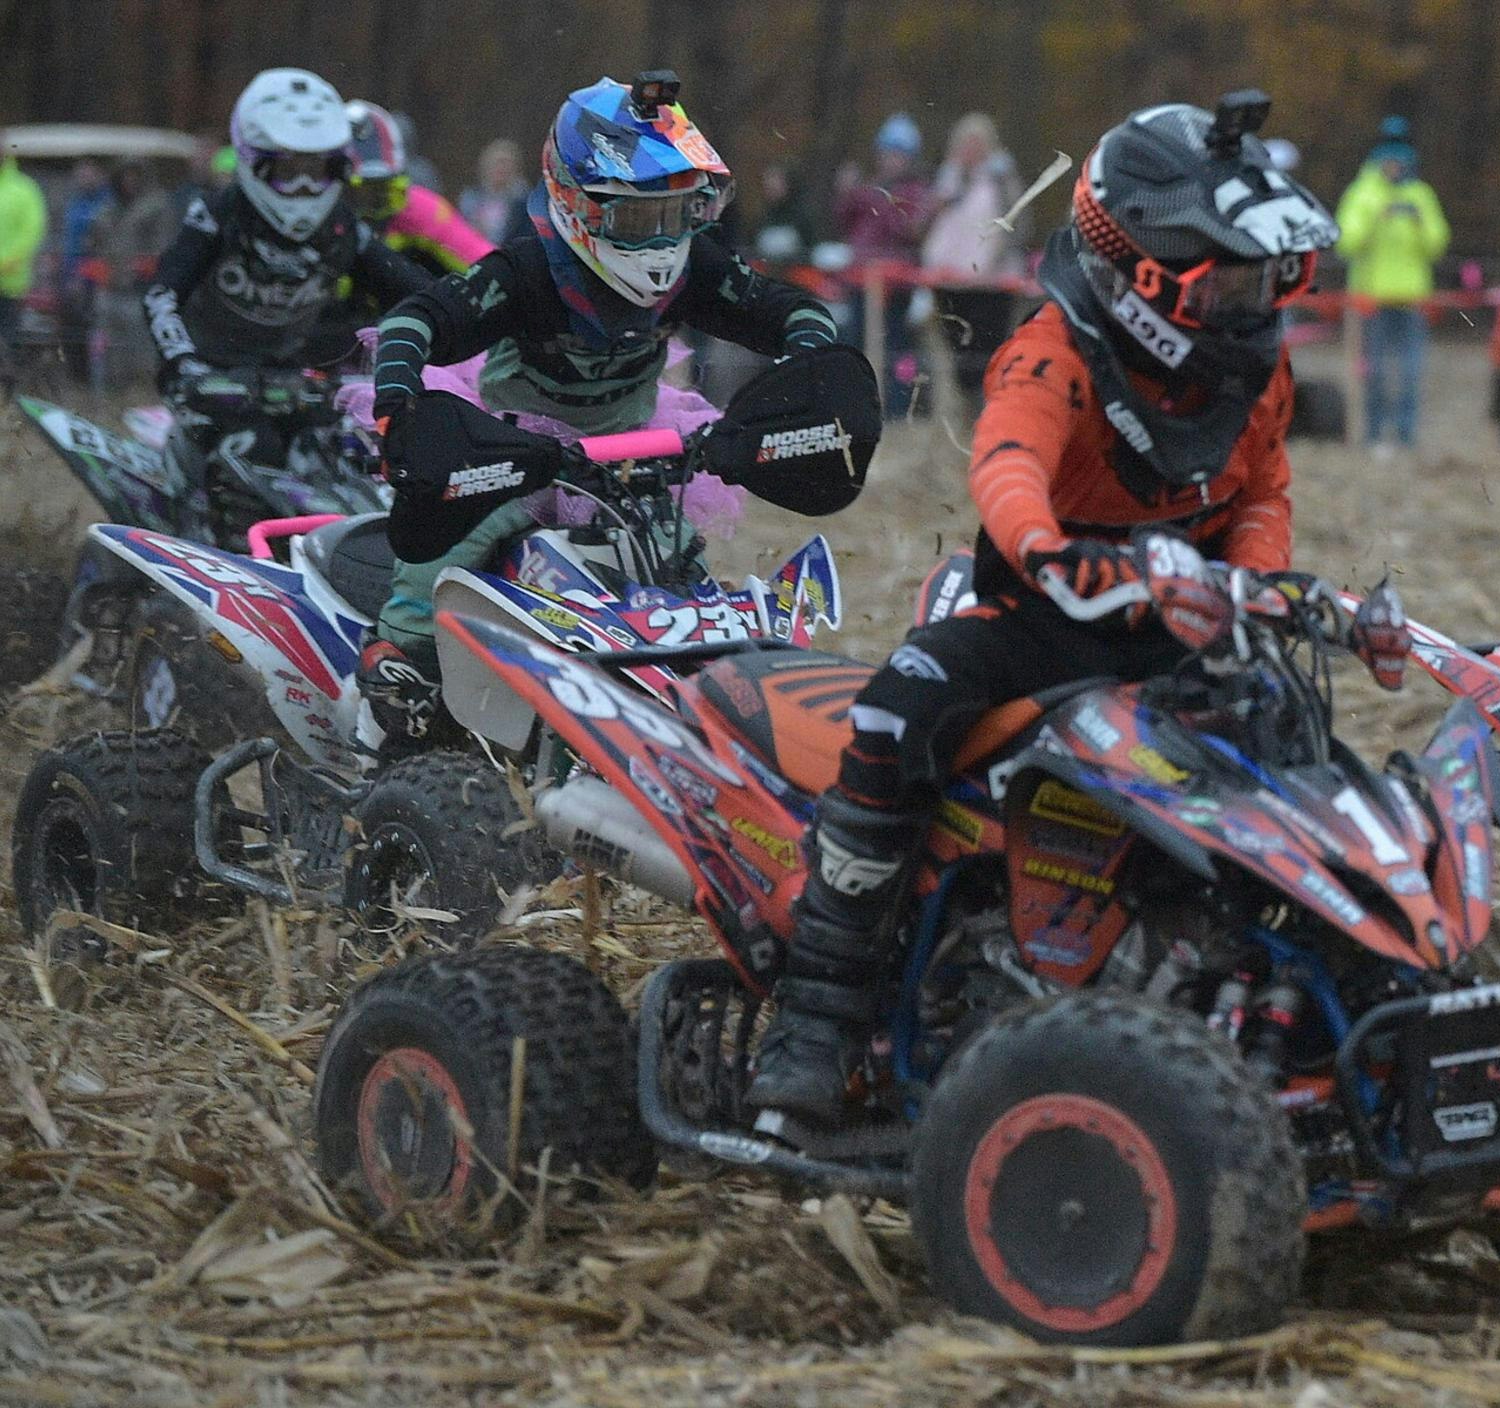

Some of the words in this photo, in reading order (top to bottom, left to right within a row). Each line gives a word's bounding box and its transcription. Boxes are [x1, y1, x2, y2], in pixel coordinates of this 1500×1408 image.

[760, 423, 837, 449] MOOSE
[772, 433, 853, 461] RACING
[448, 460, 515, 487] MOOSE
[456, 470, 527, 498] RACING
